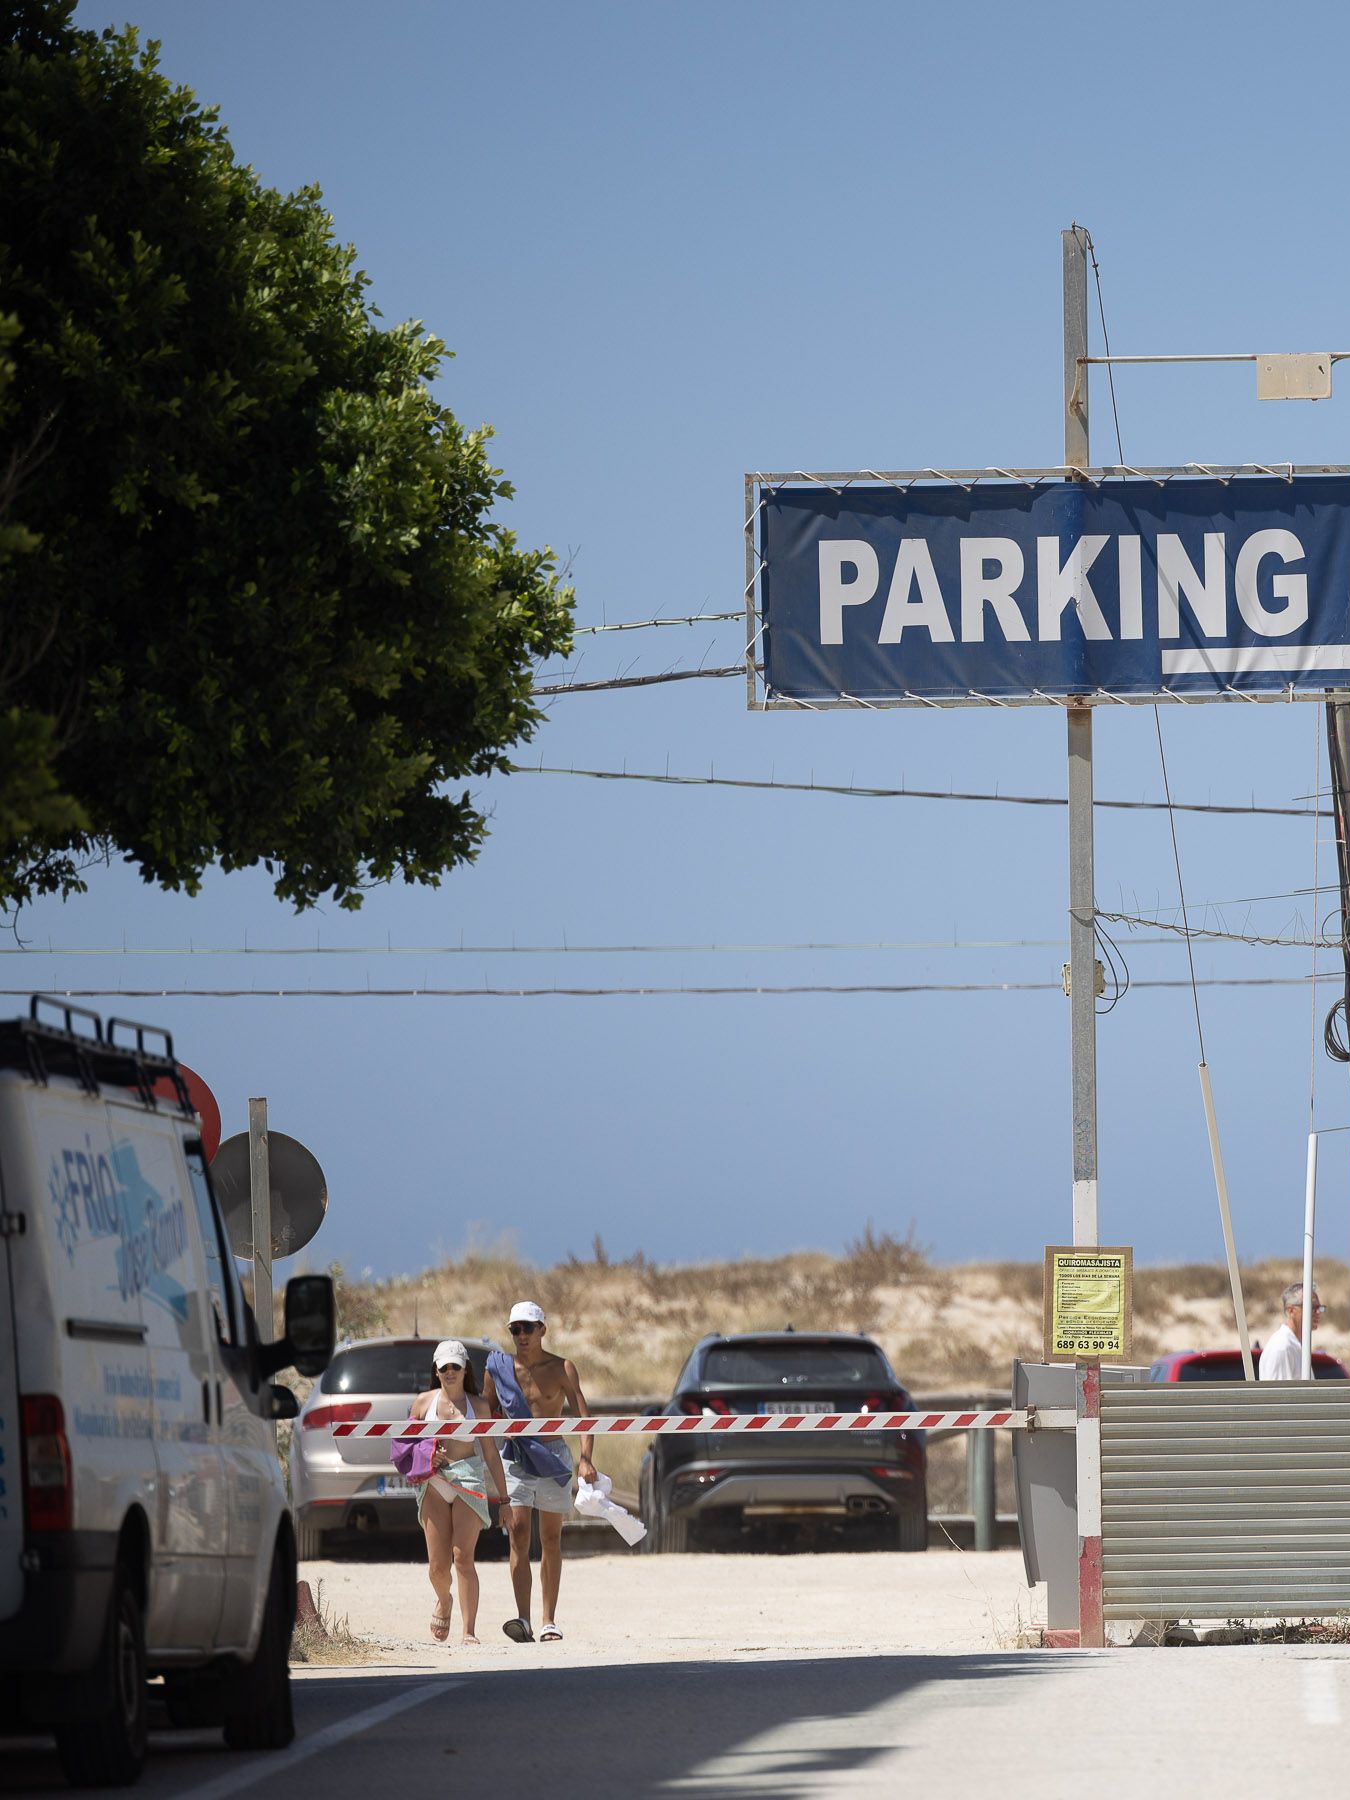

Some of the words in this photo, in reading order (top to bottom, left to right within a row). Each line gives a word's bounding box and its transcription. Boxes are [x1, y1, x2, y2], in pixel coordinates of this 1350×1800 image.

[818, 529, 1309, 645] PARKING
[1058, 1259, 1120, 1267] QUIROMASAJISTA
[1057, 1340, 1074, 1349] 689
[1078, 1340, 1090, 1349] 63
[1092, 1340, 1104, 1350] 90
[1108, 1341, 1120, 1350] 94
